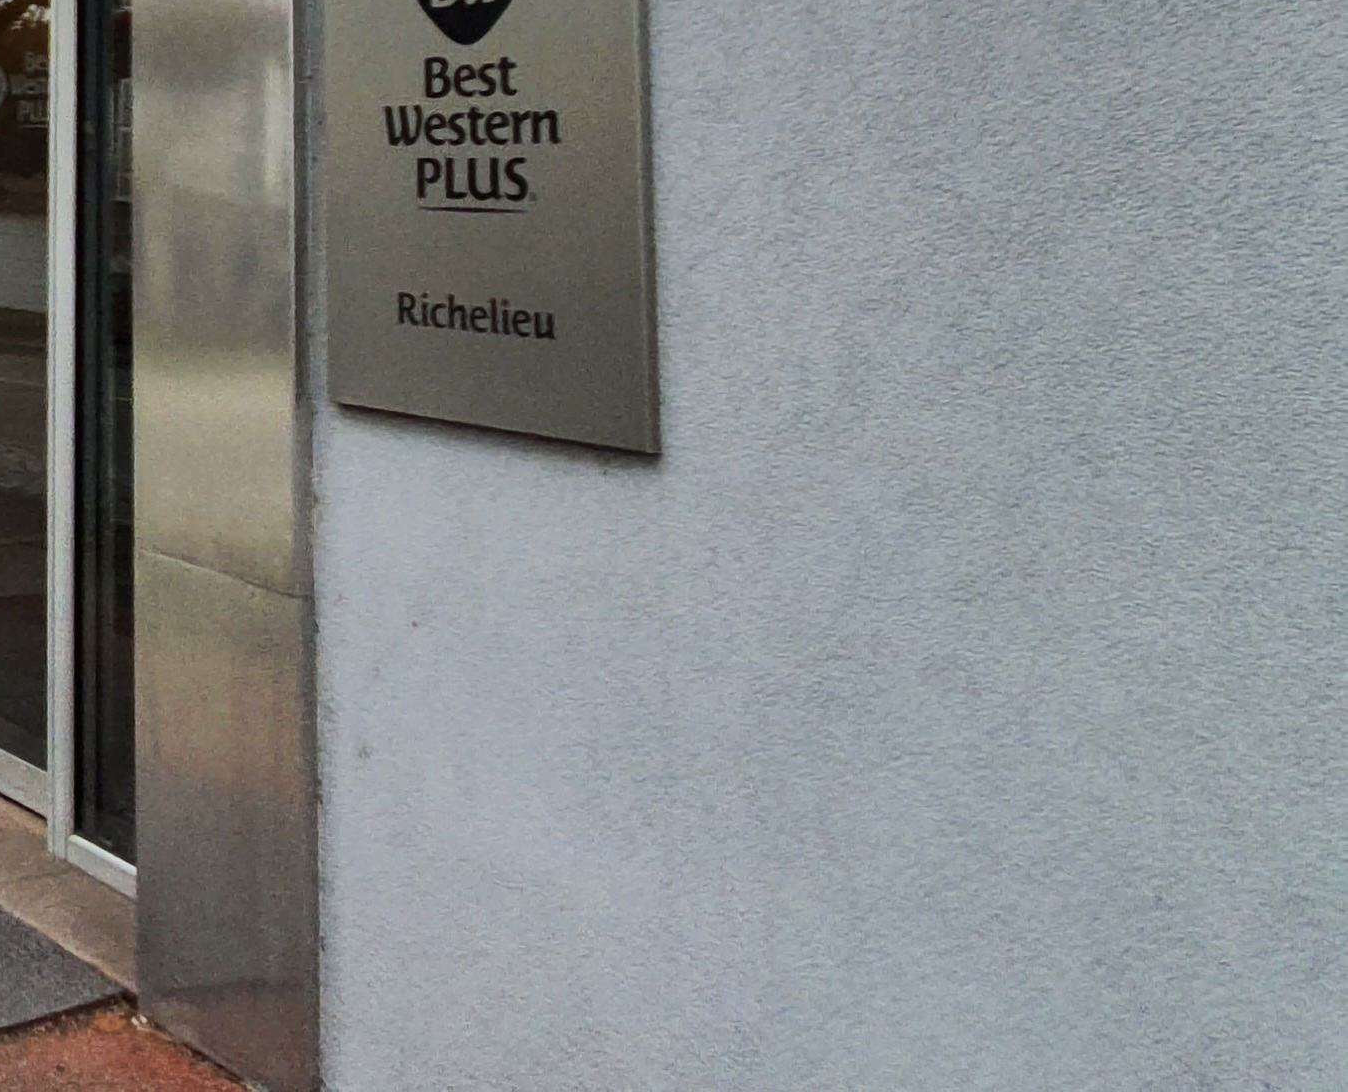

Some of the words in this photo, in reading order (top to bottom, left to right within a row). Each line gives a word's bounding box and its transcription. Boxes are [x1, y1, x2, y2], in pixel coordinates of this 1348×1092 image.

[424, 57, 517, 99] Best
[383, 105, 561, 146] Western
[416, 157, 530, 202] PLUS
[396, 291, 555, 340] Richelieu
